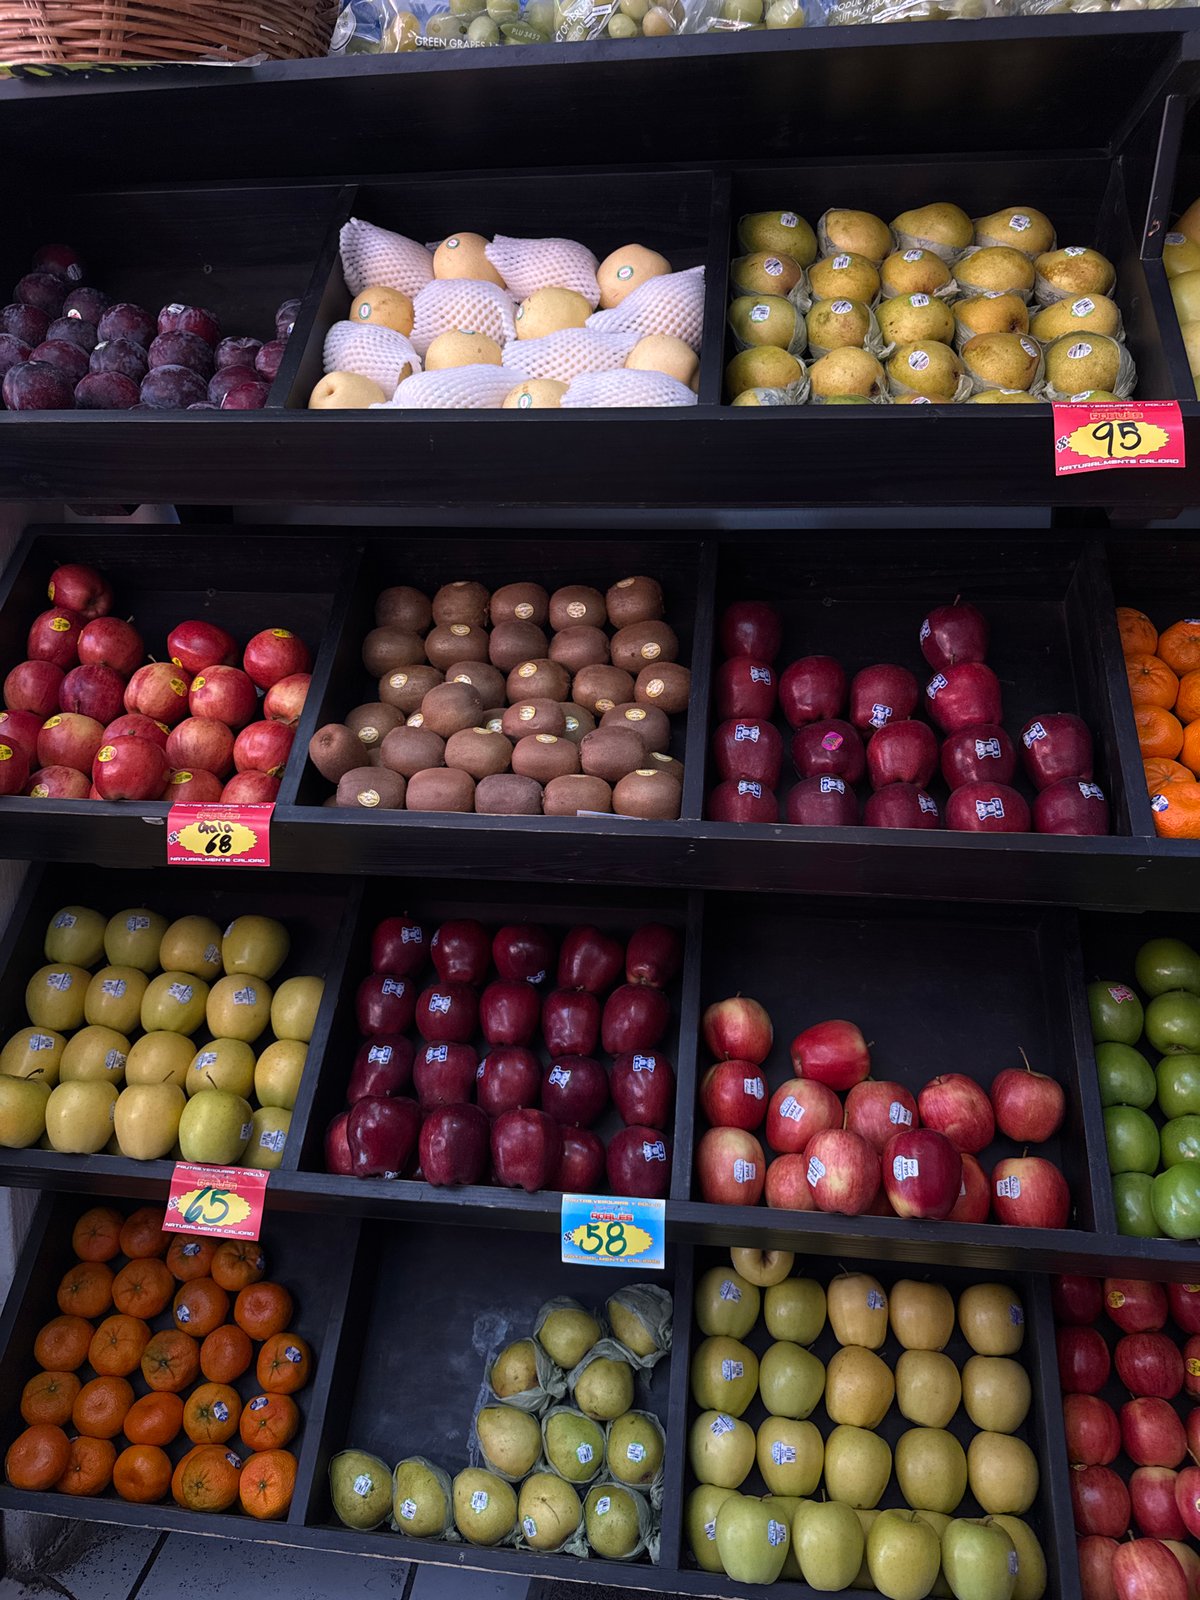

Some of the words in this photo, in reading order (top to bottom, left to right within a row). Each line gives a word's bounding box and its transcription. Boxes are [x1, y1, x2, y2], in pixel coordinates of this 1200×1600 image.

[511, 28, 524, 37] PLU
[414, 36, 448, 48] GREEN
[449, 38, 486, 49] GRAPES
[1092, 421, 1142, 457] 95
[1058, 458, 1136, 472] NATURALMENTE
[204, 833, 233, 854] 68
[183, 1185, 232, 1224] 65
[165, 1222, 222, 1233] NATURALMENTE
[579, 1221, 628, 1257] 58
